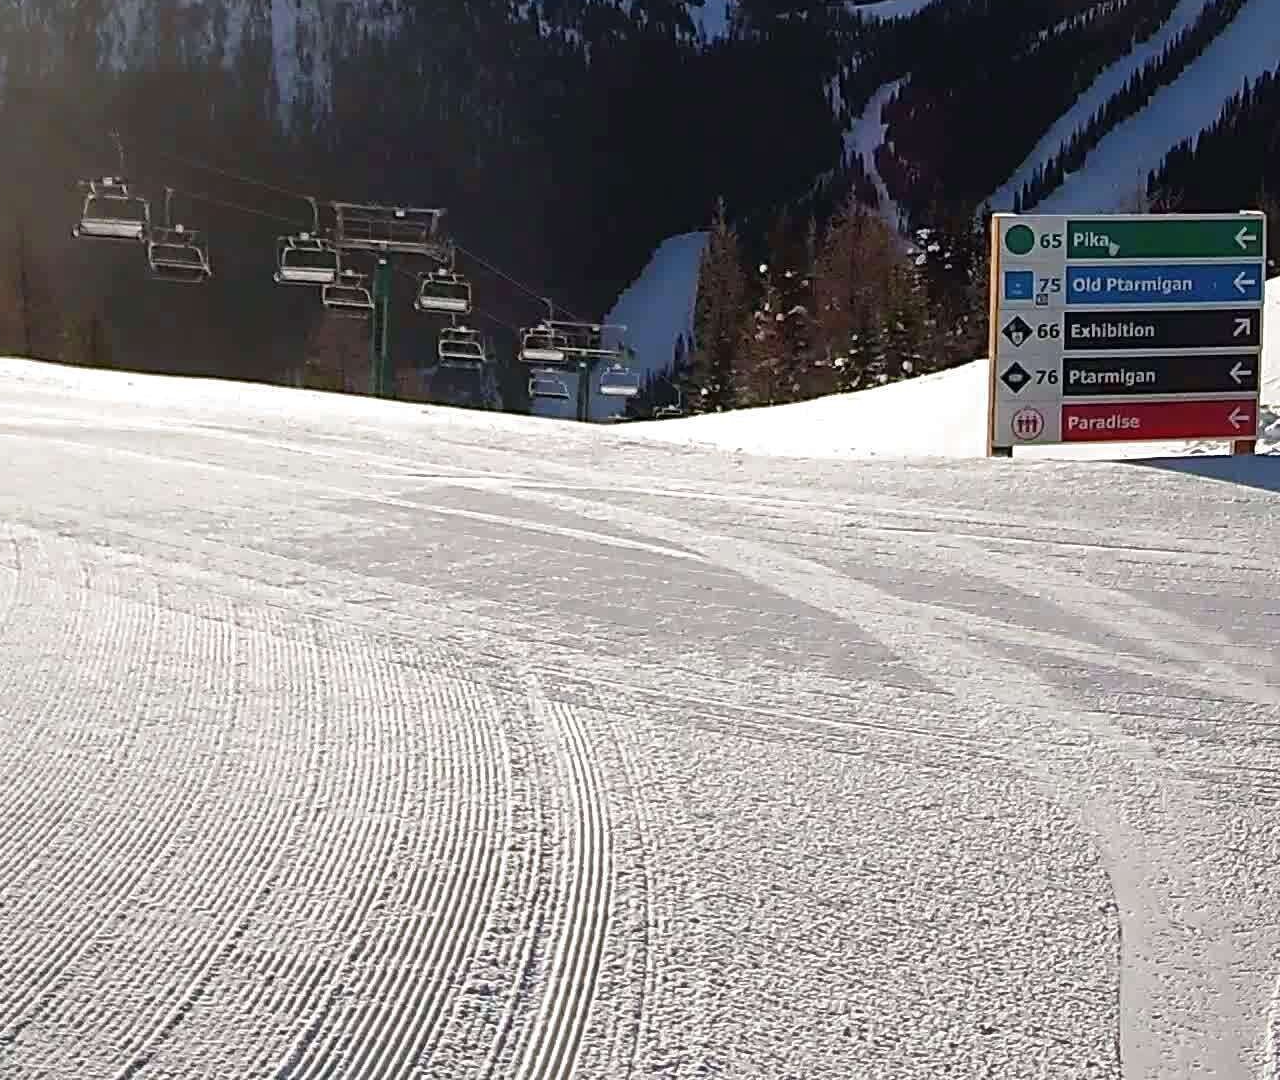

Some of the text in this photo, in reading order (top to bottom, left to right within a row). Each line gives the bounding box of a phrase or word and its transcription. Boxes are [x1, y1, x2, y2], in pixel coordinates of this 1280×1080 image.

[1040, 231, 1109, 249] 65 Pika
[1039, 276, 1193, 294] 75 Old Ptarmigan
[1037, 322, 1155, 339] 66 Exhibition
[1035, 368, 1156, 387] 76 Ptarmigan
[1067, 414, 1141, 431] Paradise
